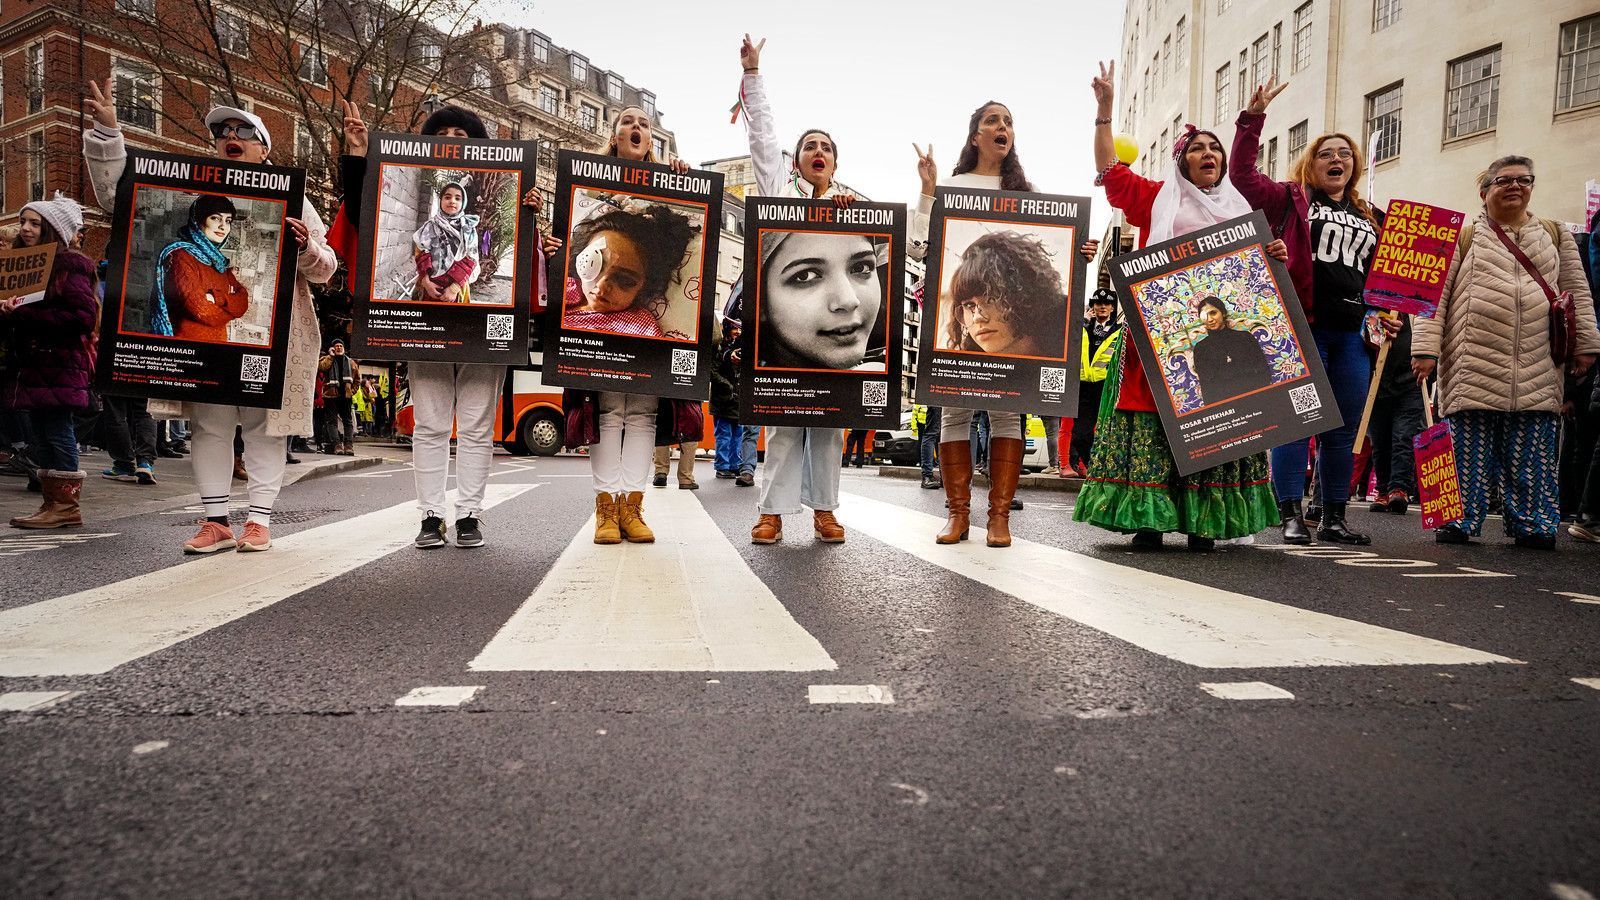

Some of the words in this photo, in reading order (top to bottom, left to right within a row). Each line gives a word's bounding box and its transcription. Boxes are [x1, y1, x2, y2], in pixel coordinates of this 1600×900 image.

[380, 139, 431, 158] WOMAN
[433, 143, 461, 160] LIFE
[464, 145, 524, 163] FREEDOM
[135, 157, 190, 181] WOMAN
[193, 164, 223, 184] LIFE
[226, 167, 291, 192] FREEDOM
[572, 159, 621, 182] WOMAN
[624, 167, 650, 186] LIFE
[653, 171, 711, 194] FREEDOM
[758, 205, 805, 222] WOMAN
[808, 207, 833, 223] LIFE
[836, 208, 894, 226] FREEDOM
[944, 194, 990, 212] WOMAN
[993, 197, 1018, 214] LIFE
[1020, 200, 1078, 218] FREEDOM
[1389, 202, 1432, 222] SAFE
[1380, 230, 1418, 248] NOT
[1384, 216, 1458, 243] PASSAGE
[1119, 249, 1171, 279] WOMAN
[1168, 240, 1198, 263] LIFE
[1195, 221, 1257, 254] FREEDOM
[1308, 221, 1377, 274] OVE
[1376, 245, 1447, 271] RWANDA
[1372, 258, 1441, 285] FLIGHTS
[116, 342, 144, 351] ELAHEH
[146, 345, 195, 356] MOHAMMADI
[560, 336, 583, 344] BENITA
[584, 339, 604, 347] KIANI
[932, 358, 957, 366] ARNIKA
[982, 362, 1015, 371] MAGHAMI
[1180, 419, 1203, 431] KOSAR
[1439, 477, 1458, 495] NOT
